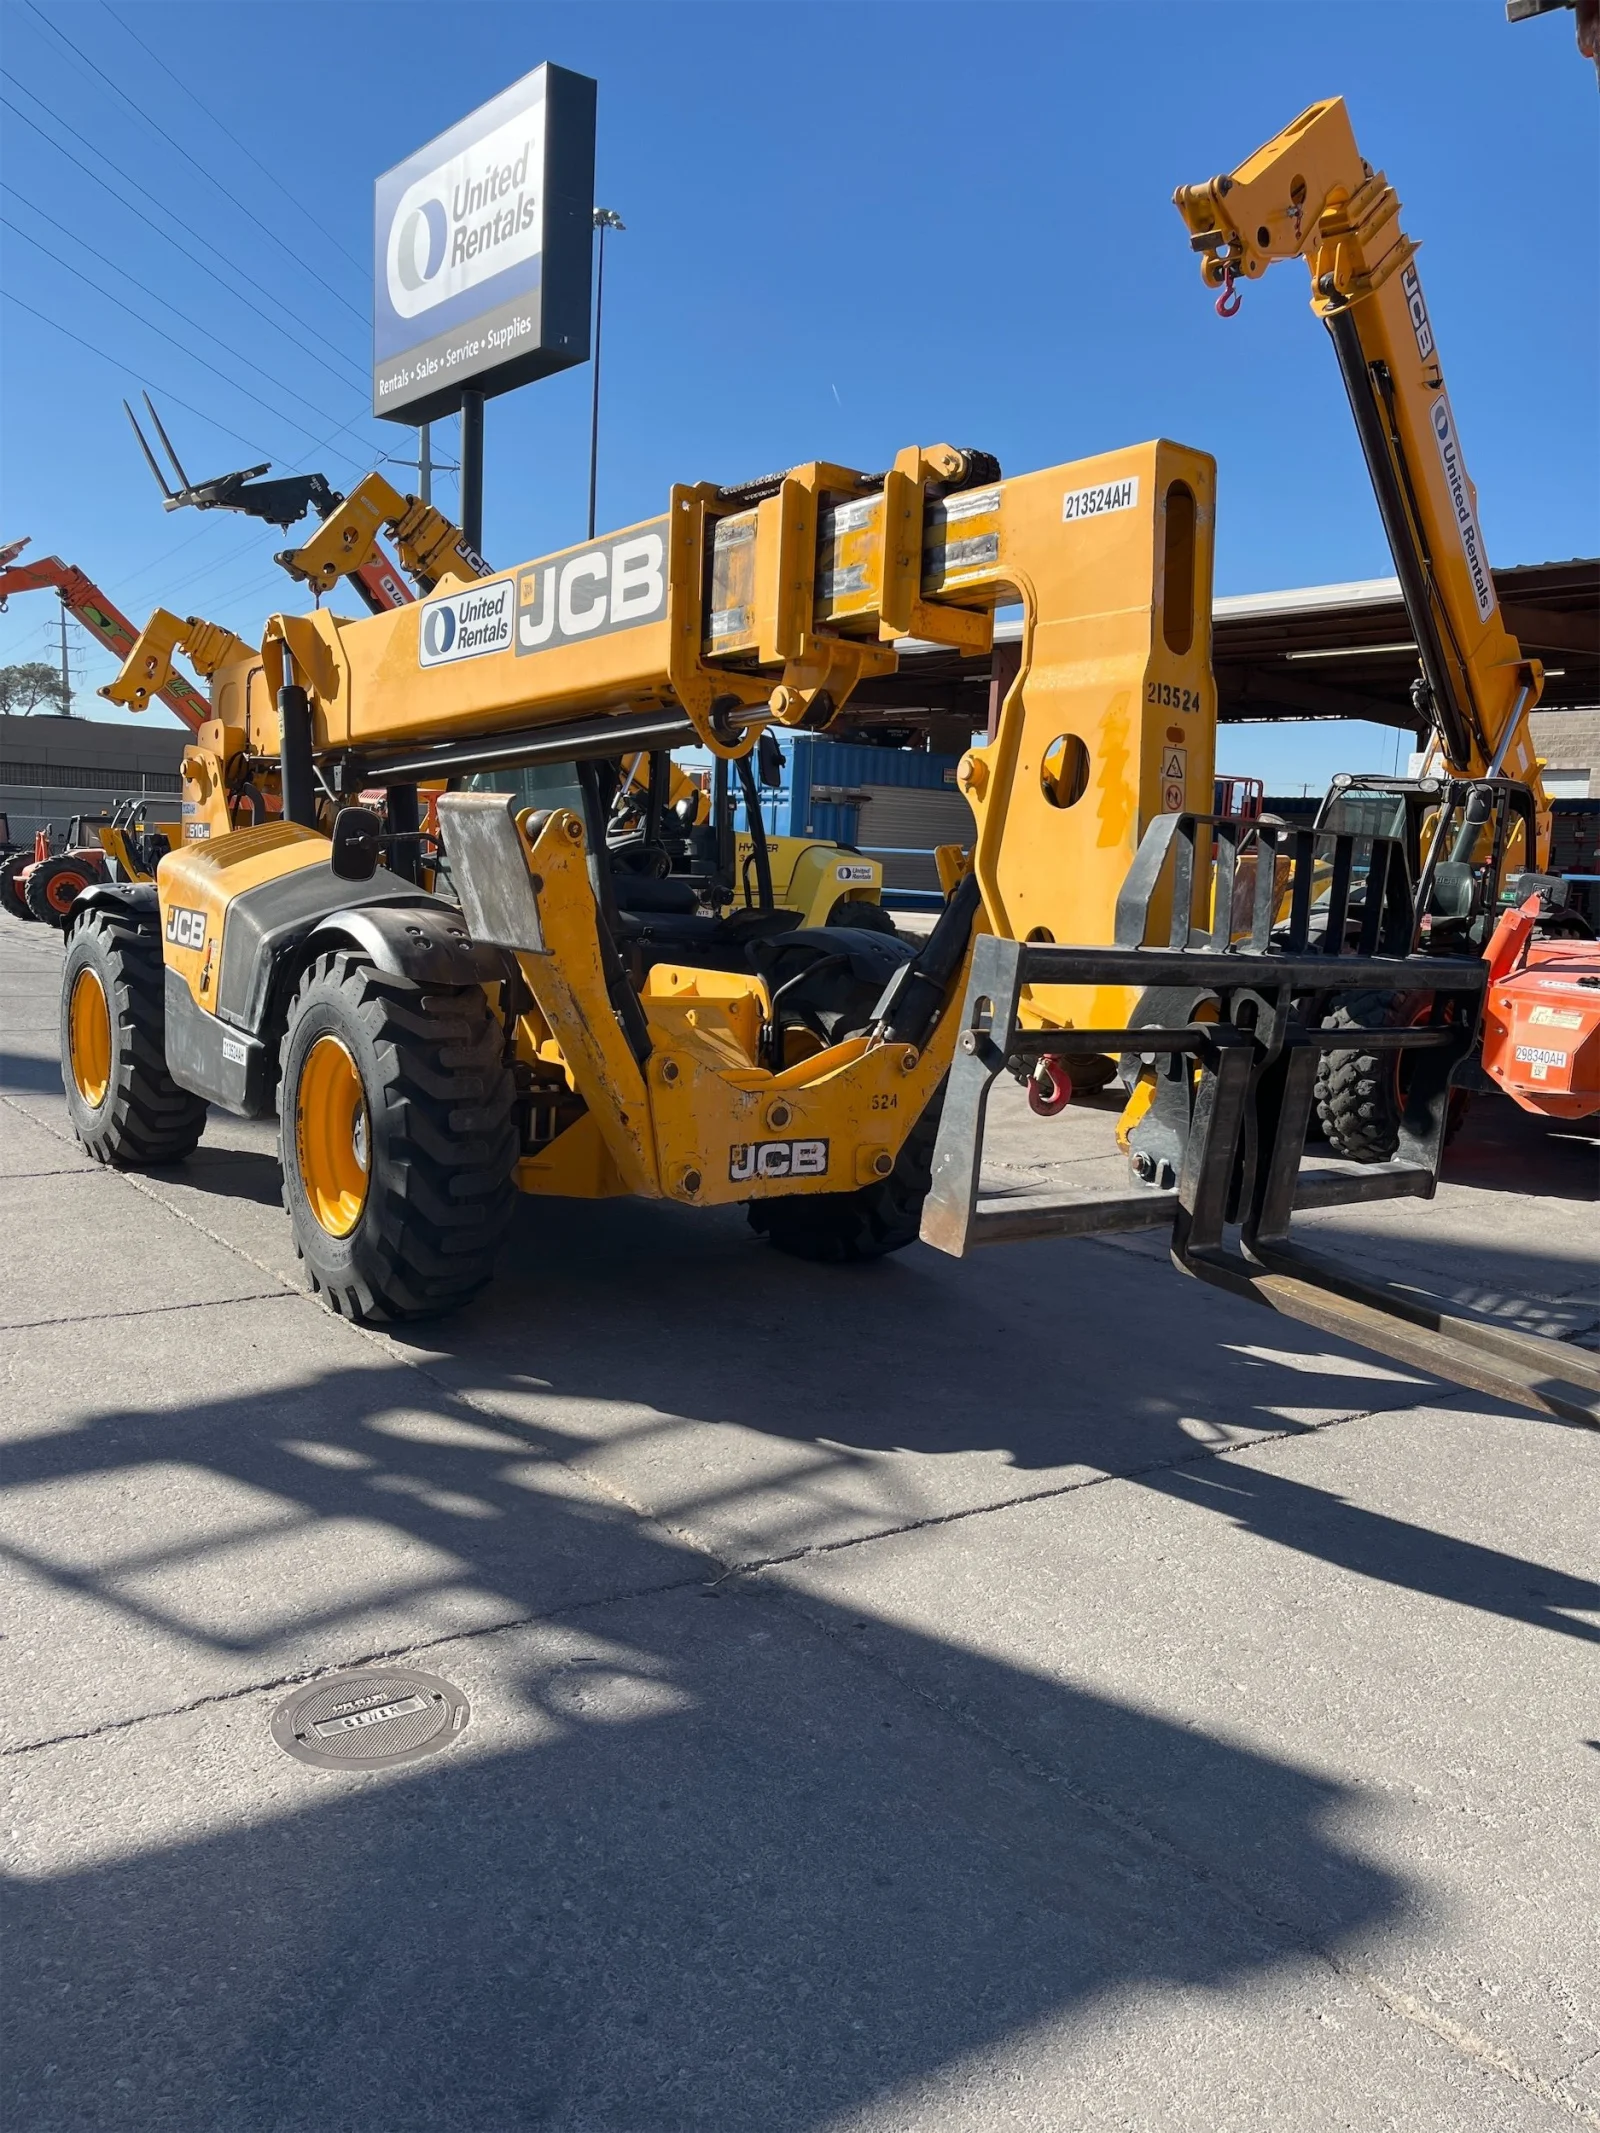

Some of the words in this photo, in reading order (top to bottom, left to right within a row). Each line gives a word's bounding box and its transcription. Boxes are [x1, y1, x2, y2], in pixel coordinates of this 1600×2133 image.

[452, 140, 530, 223] United
[451, 191, 535, 269] Rentals
[1402, 270, 1432, 358] JCB
[379, 367, 409, 397] Rentals
[416, 357, 438, 381] Sales
[446, 339, 479, 367] Service
[487, 316, 531, 354] Supplies
[1065, 482, 1132, 519] 213524AH
[1443, 441, 1470, 524] United
[1463, 524, 1489, 609] Rentals
[458, 591, 505, 624] United
[519, 533, 664, 647] JCB
[457, 617, 508, 650] Rentals
[1147, 682, 1200, 713] 213524
[738, 842, 779, 853] HYER
[167, 908, 206, 949] JCB
[1516, 1047, 1564, 1066] 298340AH
[730, 1141, 826, 1180] JCB
[342, 1705, 401, 1728] SEWER
